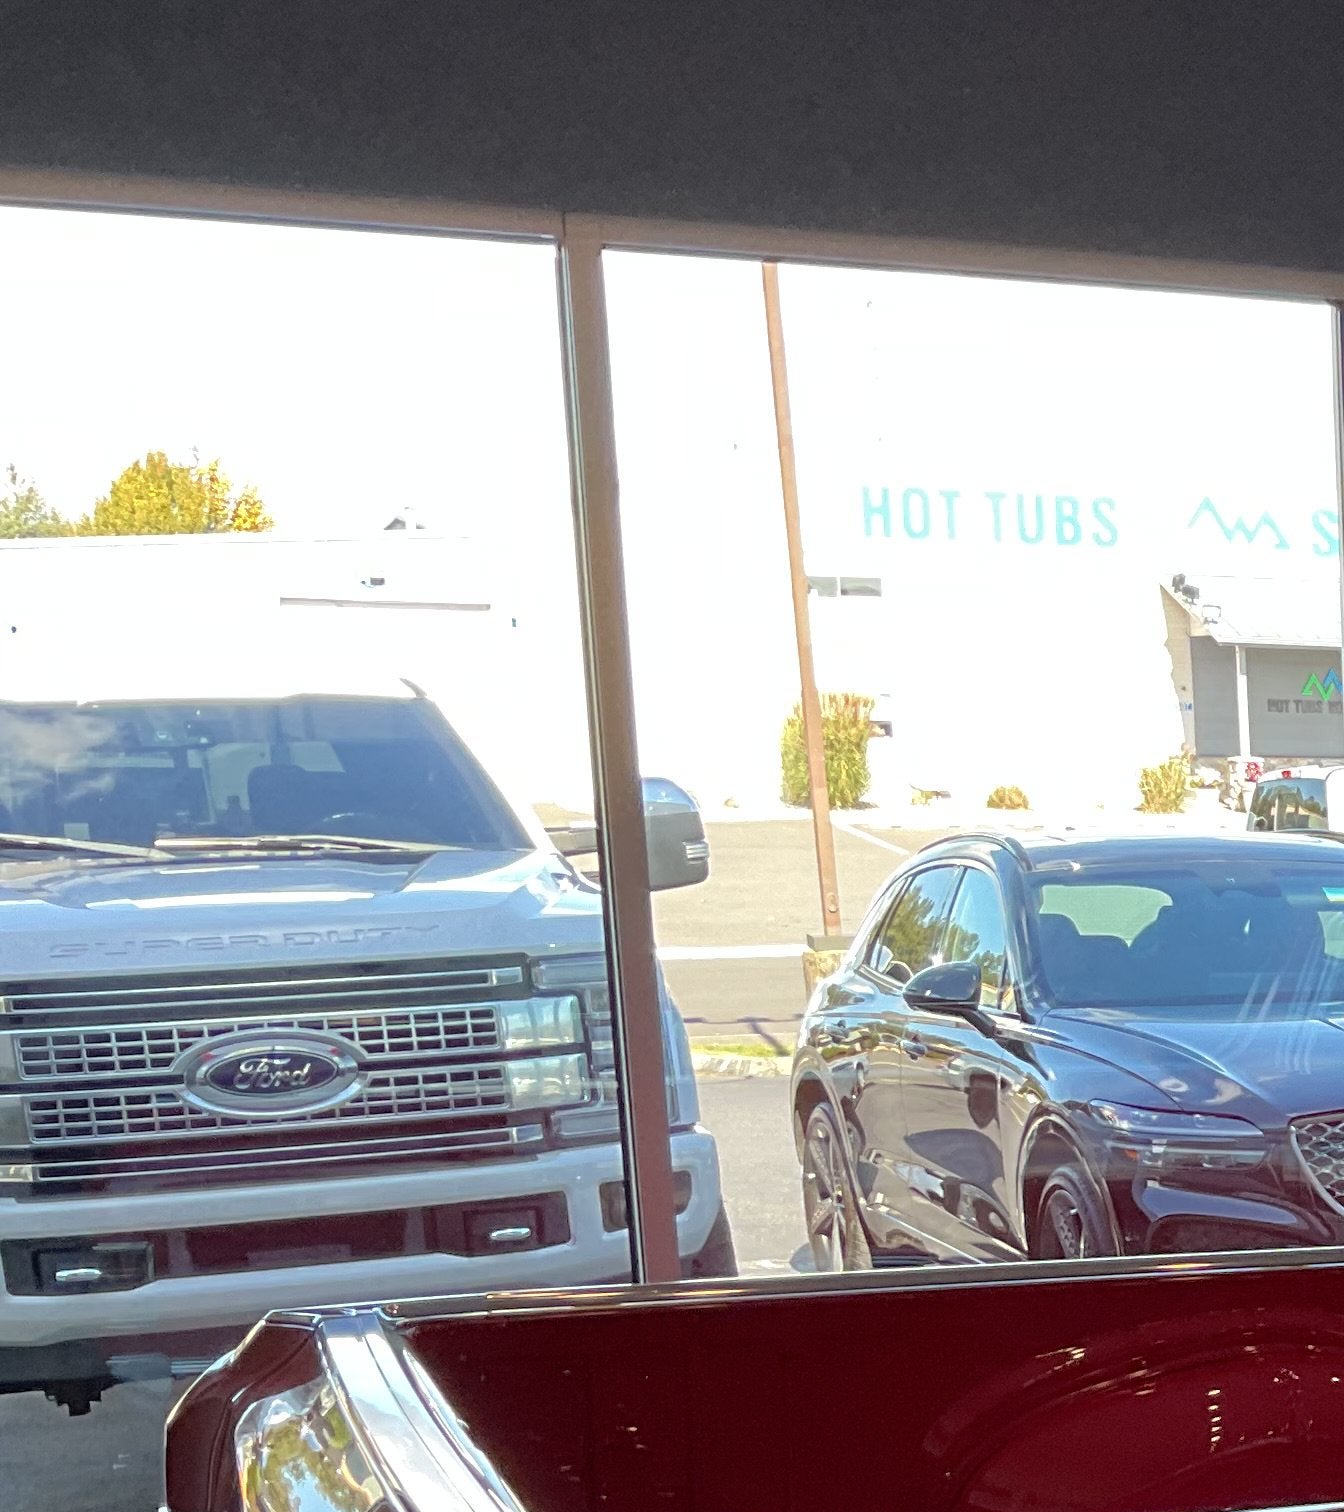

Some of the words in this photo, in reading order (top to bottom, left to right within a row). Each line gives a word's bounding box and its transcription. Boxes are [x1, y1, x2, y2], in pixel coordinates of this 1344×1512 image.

[861, 485, 961, 541] HOT
[983, 490, 1119, 547] TUBS
[48, 935, 271, 959] SUPER
[283, 923, 441, 947] DUTY
[233, 1056, 313, 1091] Ford
